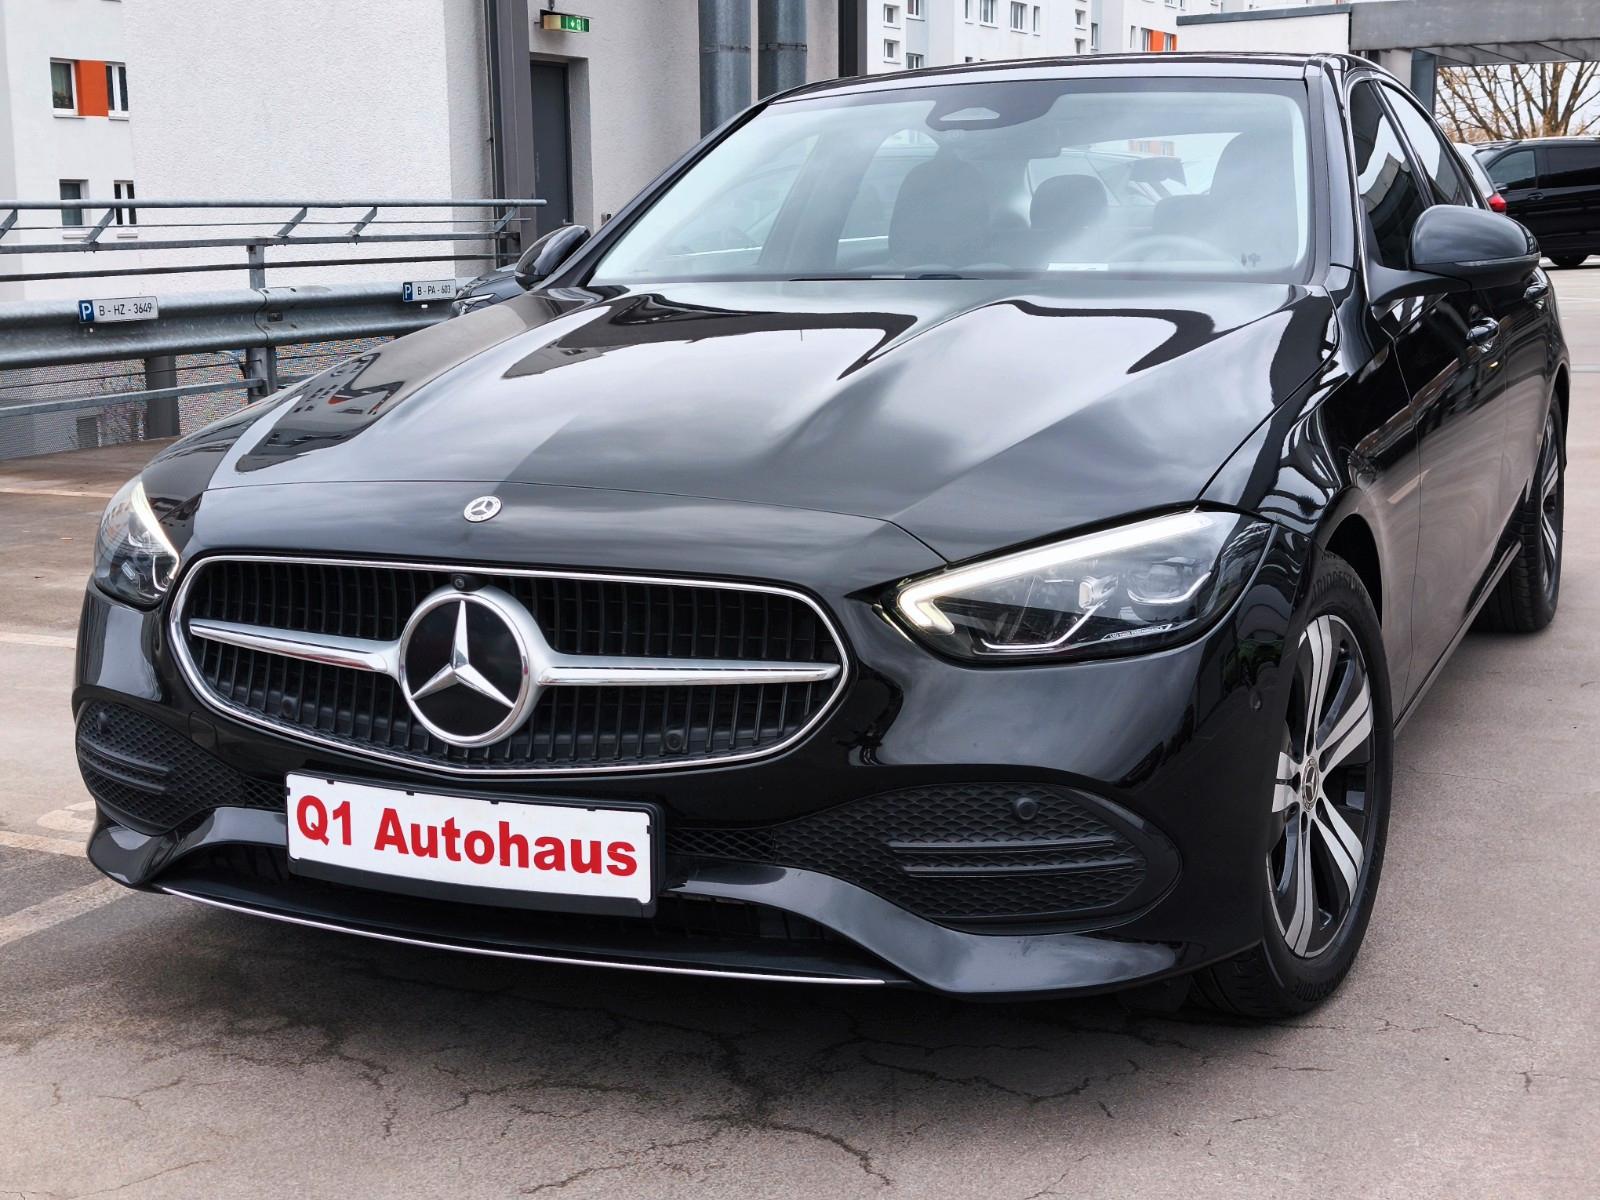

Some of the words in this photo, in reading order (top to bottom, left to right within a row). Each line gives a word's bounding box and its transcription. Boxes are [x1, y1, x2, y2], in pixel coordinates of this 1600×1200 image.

[404, 284, 412, 299] P
[417, 286, 422, 296] B
[427, 285, 436, 295] PA
[81, 303, 92, 320] P
[98, 305, 105, 316] B
[113, 304, 126, 315] HZ
[133, 302, 152, 314] 3649
[296, 795, 352, 846] Q1
[374, 807, 638, 877] Autohaus
